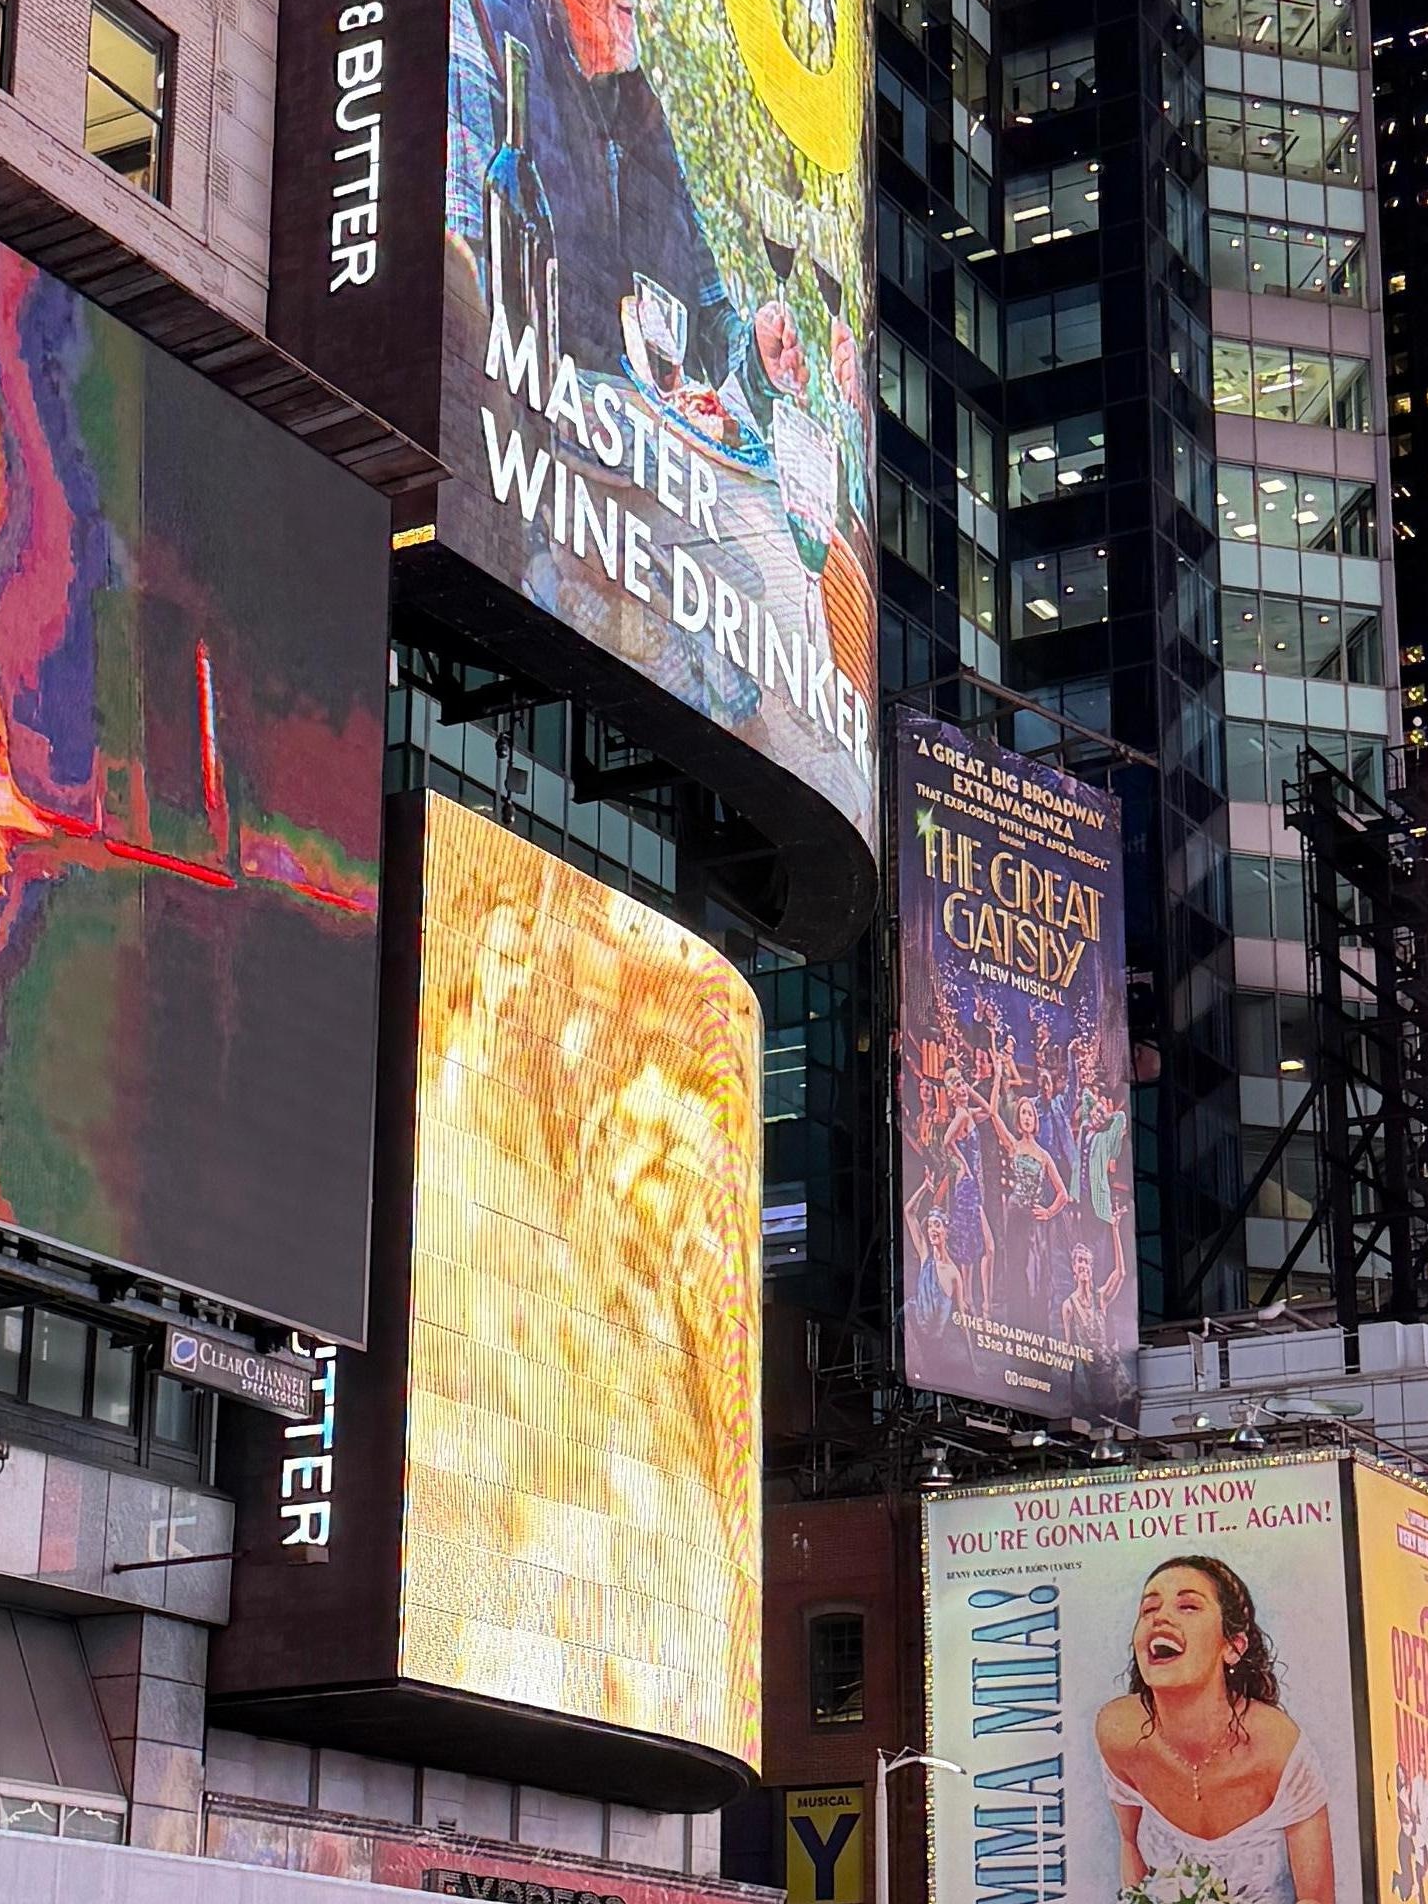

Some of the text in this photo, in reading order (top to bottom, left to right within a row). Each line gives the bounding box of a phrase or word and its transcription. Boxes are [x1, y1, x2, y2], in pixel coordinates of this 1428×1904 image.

[340, 2, 372, 32] &
[329, 37, 383, 294] BUTTER
[485, 303, 722, 543] MASTER
[481, 406, 871, 780] WINE DRINKER
[915, 782, 942, 802] THAT
[943, 793, 996, 825] EXPLODES
[997, 815, 1023, 836] WITH
[1024, 827, 1045, 846] LIFE
[1046, 838, 1067, 854] AND
[932, 742, 988, 783] GREAT,
[991, 766, 1019, 793] BIG
[1022, 779, 1106, 831] BROADWAY
[953, 773, 1075, 841] EXTRAVAGANZA
[924, 826, 1105, 942] THE GREAT
[943, 892, 1086, 988] GATSBY
[969, 957, 1065, 1006] A NEW MUSICAL
[962, 1313, 1094, 1362] THE BROADWAY THEATRE
[1015, 1344, 1074, 1372] BROADWAY
[241, 1378, 305, 1410] SPECTACOLOR
[947, 1500, 1333, 1555] YOU'RE GONNA LOVE IT... AGAIN!
[1013, 1479, 1258, 1523] YOU ALREADY KNOW
[968, 1584, 1063, 1739] MIA!
[797, 1795, 852, 1809] MUSICAL
[789, 1812, 861, 1901] Y
